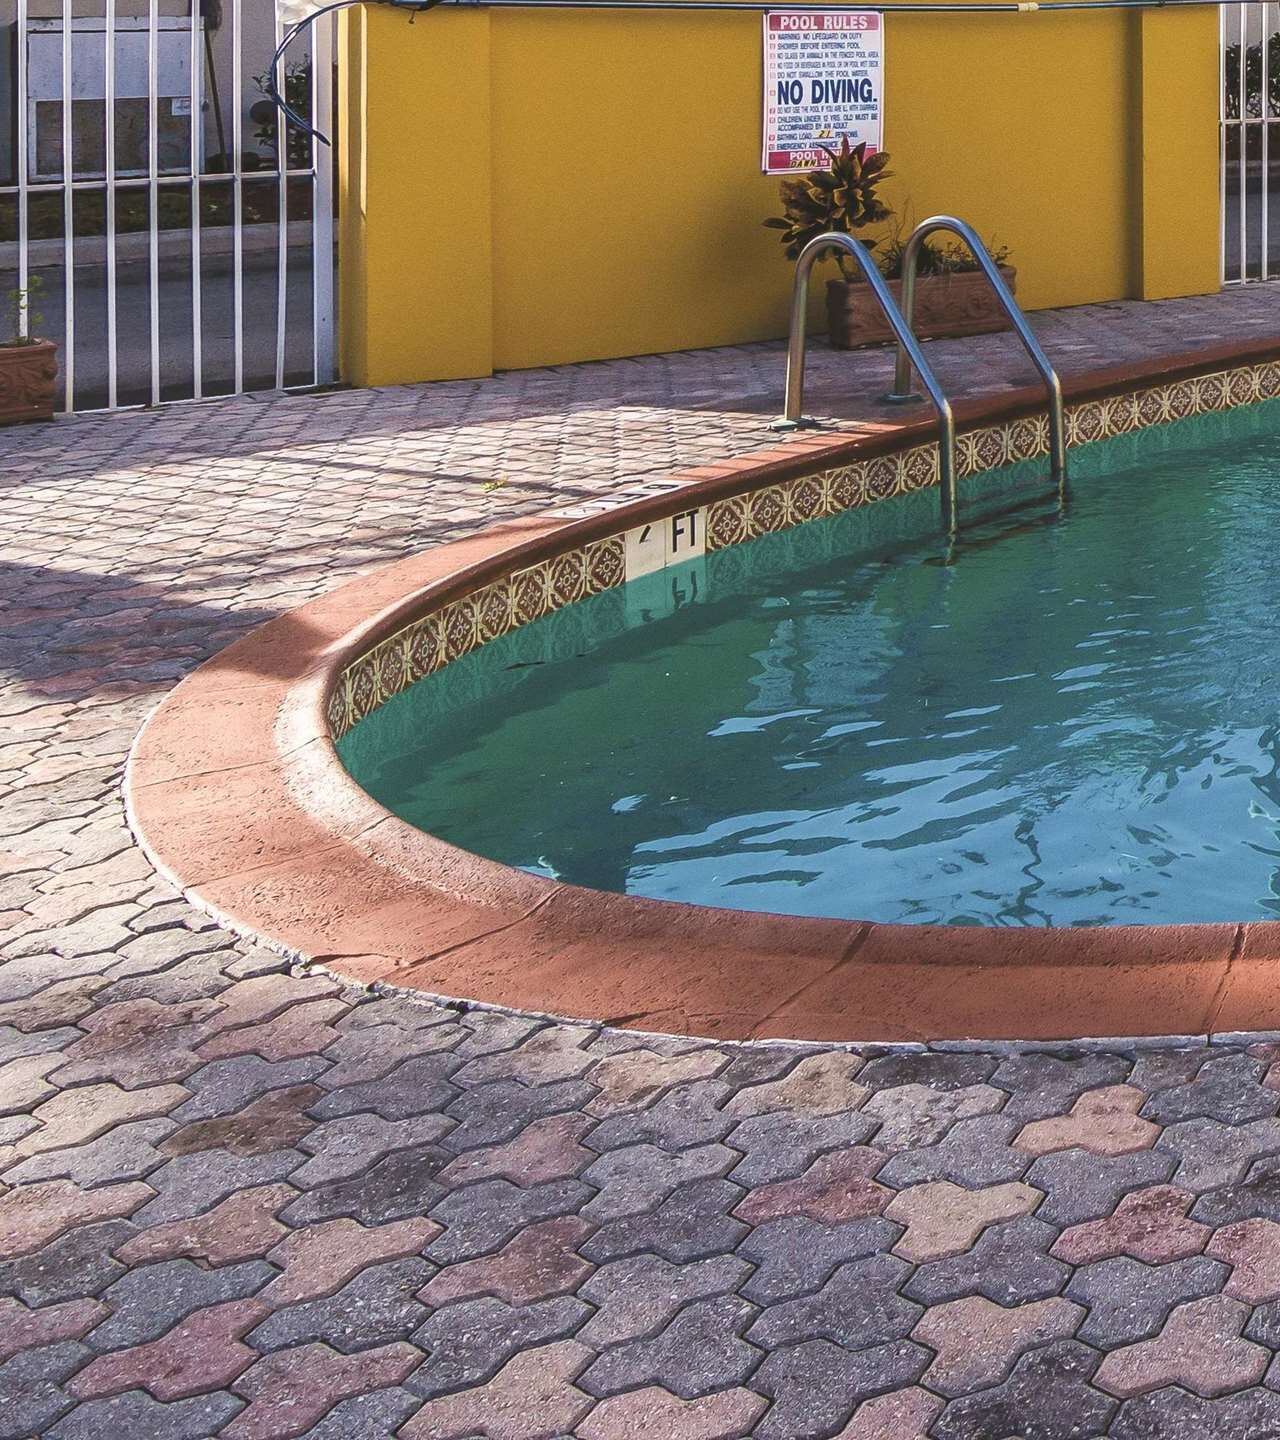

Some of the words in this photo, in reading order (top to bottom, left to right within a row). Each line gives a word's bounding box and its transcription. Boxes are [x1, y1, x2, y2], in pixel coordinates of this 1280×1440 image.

[780, 16, 818, 30] POOL
[824, 15, 868, 29] RULES
[777, 79, 803, 105] NO
[811, 78, 877, 104] DIVING.
[777, 116, 802, 124] CHILDREN
[790, 151, 818, 160] POOL
[672, 508, 699, 553] FT
